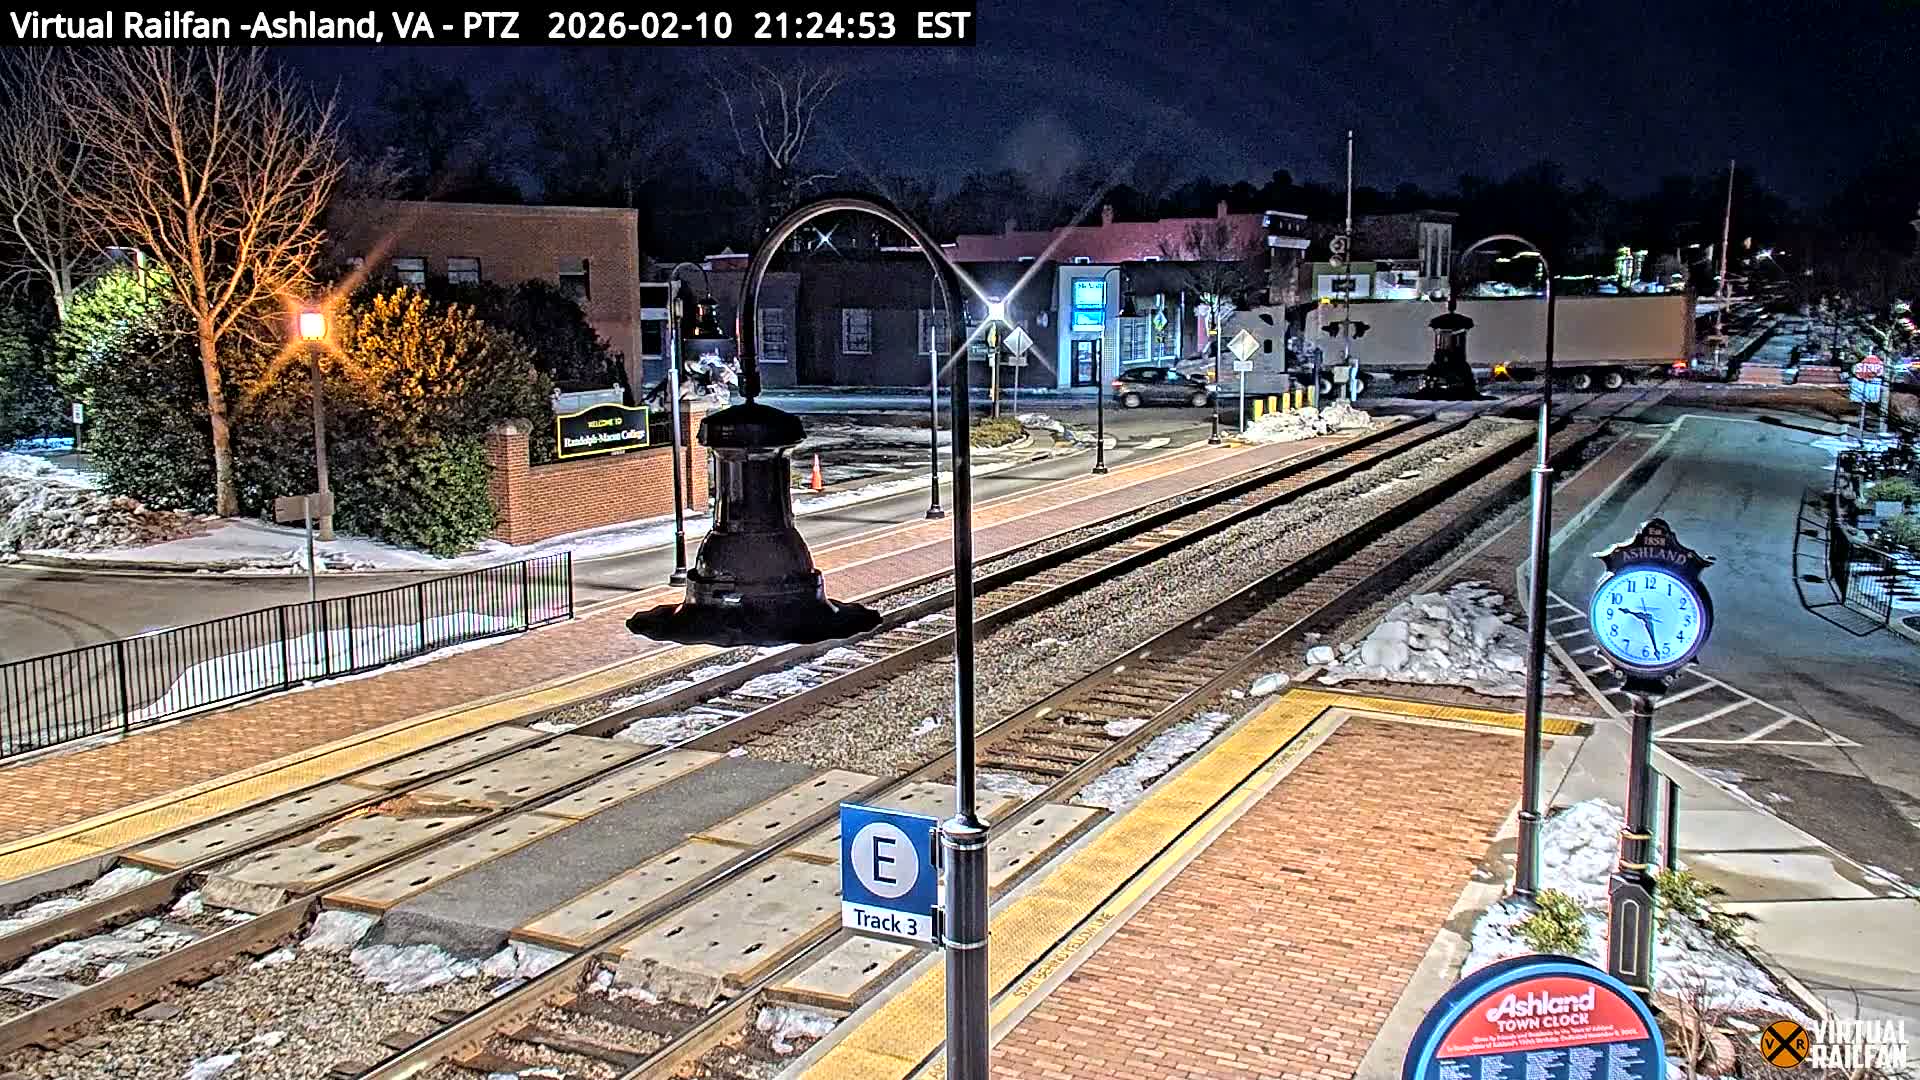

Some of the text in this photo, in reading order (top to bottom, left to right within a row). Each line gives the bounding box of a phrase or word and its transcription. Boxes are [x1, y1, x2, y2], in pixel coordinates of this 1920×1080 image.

[1855, 362, 1883, 374] STOP
[1622, 547, 1687, 565] ASHLAND
[1627, 580, 1636, 593] 11
[1645, 576, 1657, 590] 12
[1667, 583, 1672, 596] 1
[1611, 592, 1623, 605] 10
[1678, 597, 1687, 610] 2
[1606, 607, 1614, 621] 9
[1683, 615, 1692, 628] 3
[1609, 623, 1619, 638] 8
[1676, 630, 1685, 643] 4
[1622, 638, 1630, 654] 7
[1642, 645, 1650, 658] 6
[1661, 642, 1671, 655] 5
[873, 835, 897, 885] E
[853, 907, 917, 936] Track 3
[1486, 986, 1595, 1022] Ashland
[1498, 1012, 1589, 1032] TOWN CLOCK
